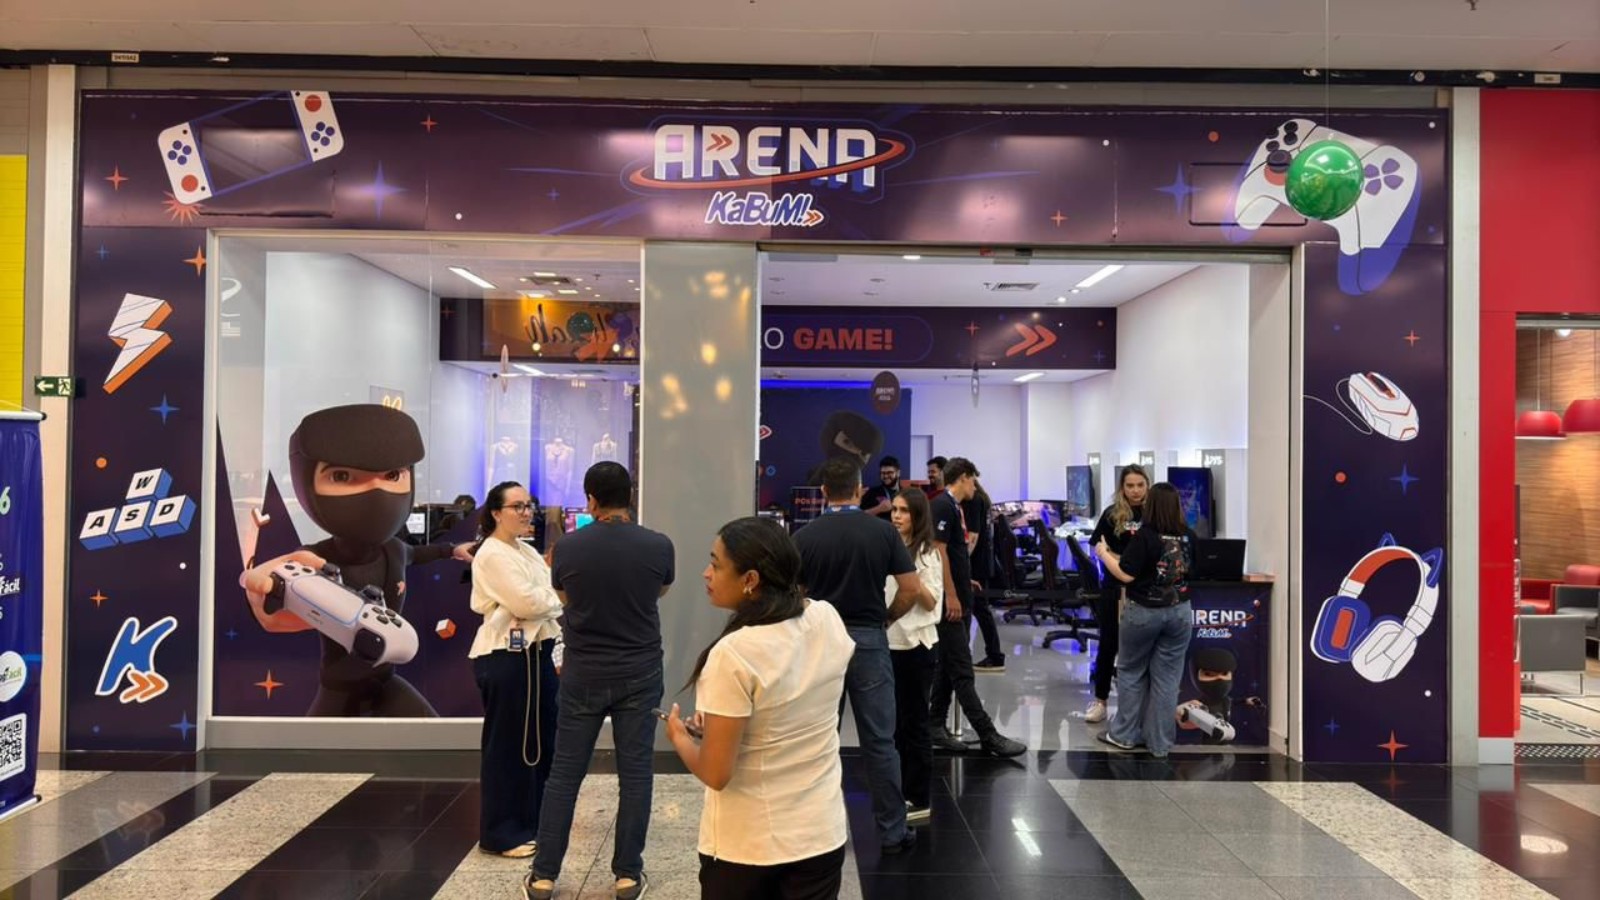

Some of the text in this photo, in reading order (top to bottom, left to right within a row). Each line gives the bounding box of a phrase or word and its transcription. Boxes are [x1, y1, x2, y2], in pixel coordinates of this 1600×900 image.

[654, 124, 877, 188] ARENA
[704, 191, 813, 226] KaBuM!
[760, 327, 893, 351] O GAME!
[135, 475, 154, 490] W
[88, 503, 175, 530] A S D
[95, 616, 178, 696] K
